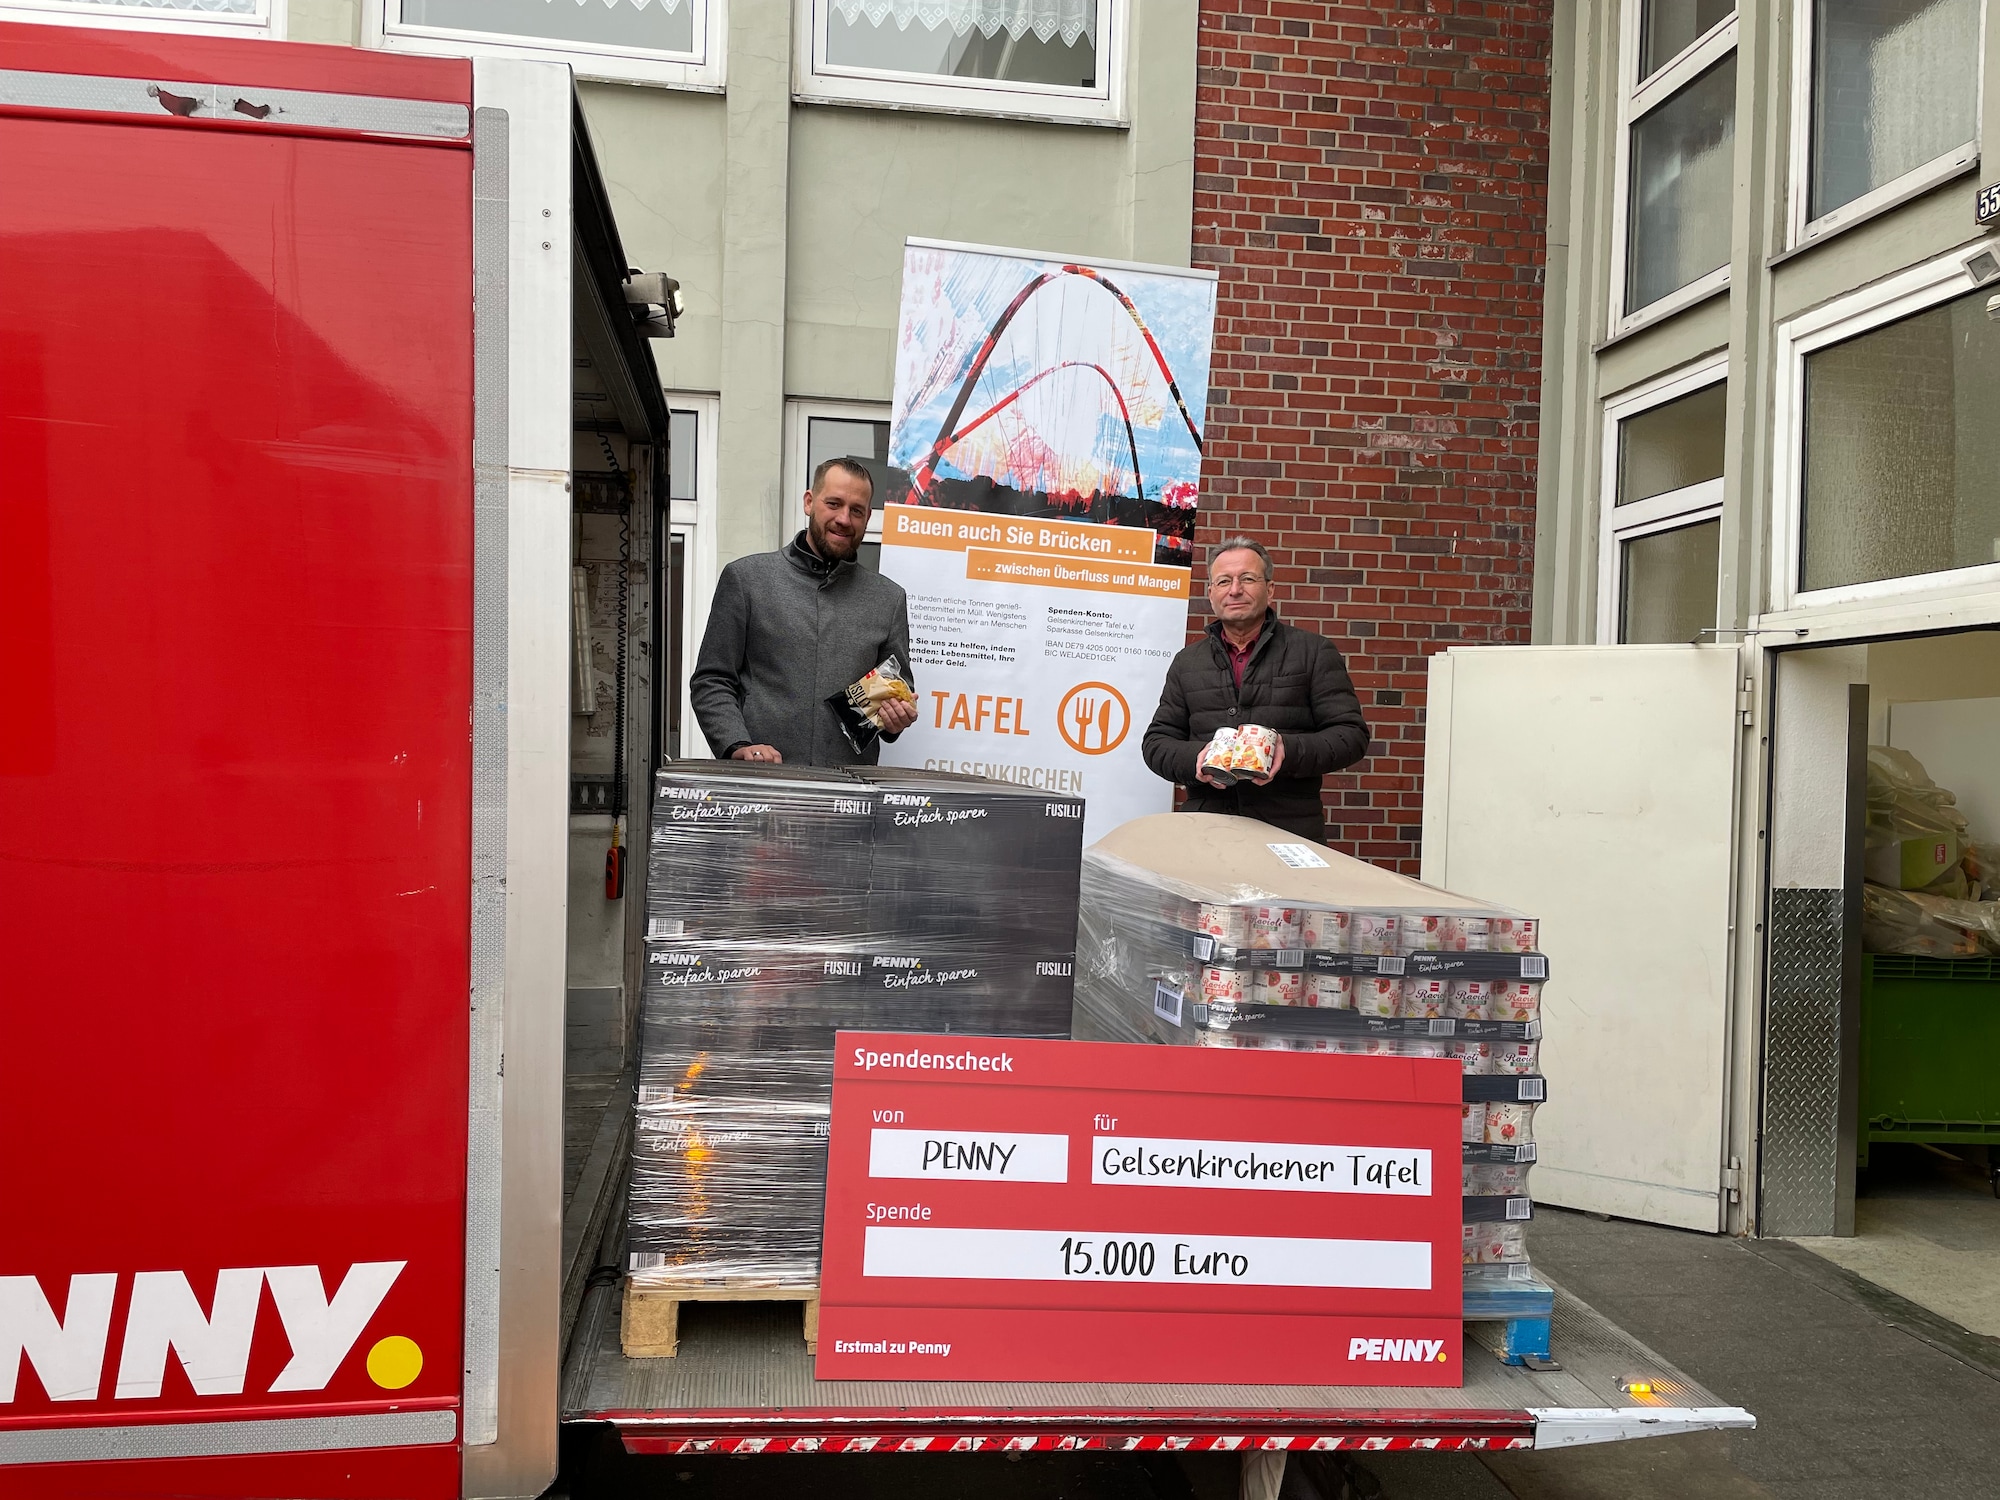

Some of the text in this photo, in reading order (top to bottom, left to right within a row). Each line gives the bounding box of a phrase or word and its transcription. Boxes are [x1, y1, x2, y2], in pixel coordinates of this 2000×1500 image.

[1979, 185, 2000, 218] 55
[897, 515, 953, 537] Bauen
[958, 521, 1001, 542] auch
[1006, 526, 1034, 545] Sie
[1039, 528, 1112, 553] Brücken
[995, 562, 1050, 578] zwischen
[1053, 564, 1109, 584] Überfluss
[1112, 572, 1134, 586] und
[1138, 575, 1181, 591] Mangel
[918, 594, 942, 604] landen
[943, 596, 967, 605] etliche
[969, 599, 994, 609] Tonnen
[995, 602, 1022, 612] genieß-
[910, 603, 956, 614] Lebensmittel
[968, 608, 984, 617] Müll.
[986, 610, 1027, 621] Wenigstens
[1048, 606, 1113, 619] Spenden-Konto:
[910, 612, 922, 620] Teil
[923, 613, 946, 623] davon
[947, 616, 966, 625] leiten
[990, 620, 1027, 630] Menschen
[916, 624, 937, 632] wenig
[939, 624, 963, 634] haben.
[1047, 616, 1103, 628] Gelsenkirchener
[1105, 621, 1121, 630] Tafel
[1046, 625, 1134, 640] Sparkasse Gelsenkirchen
[915, 637, 929, 645] Sie
[960, 641, 988, 651] helfen,
[990, 643, 1016, 653] indem
[1045, 640, 1064, 648] IBAN
[1065, 642, 1084, 650] DE79
[1105, 645, 1122, 653] 0001
[941, 649, 997, 661] Lebensmittel,
[999, 654, 1015, 663] Ihre
[946, 659, 967, 667] Geld.
[1044, 649, 1117, 662] BIC WELADED1GEK
[931, 691, 1030, 736] TAFEL
[671, 802, 771, 822] Einfach sparen
[834, 799, 871, 815] FUSILLI
[1045, 803, 1081, 818] FUSILLI
[893, 807, 988, 827] Einfach sparen
[1250, 914, 1283, 927] Ravioli
[823, 961, 861, 976] FUSILLI
[1036, 961, 1073, 976] FUSILLI
[1418, 961, 1443, 973] Einfach
[661, 966, 761, 987] Einfach sparen
[883, 968, 978, 989] Einfach sparen
[1202, 977, 1233, 990] Ravioli
[1455, 990, 1490, 1001] Ravioli
[853, 1048, 1014, 1072] Spendenscheck
[872, 1109, 905, 1123] von
[1093, 1114, 1118, 1132] für
[652, 1131, 751, 1153] Einfach sparen
[922, 1140, 1017, 1174] PENNY
[1102, 1148, 1422, 1188] Gelsenkirchener Tafel
[866, 1202, 932, 1223] Spende
[1059, 1237, 1249, 1277] 15.000 Euro
[835, 1340, 951, 1357] Erstmal zu Penny
